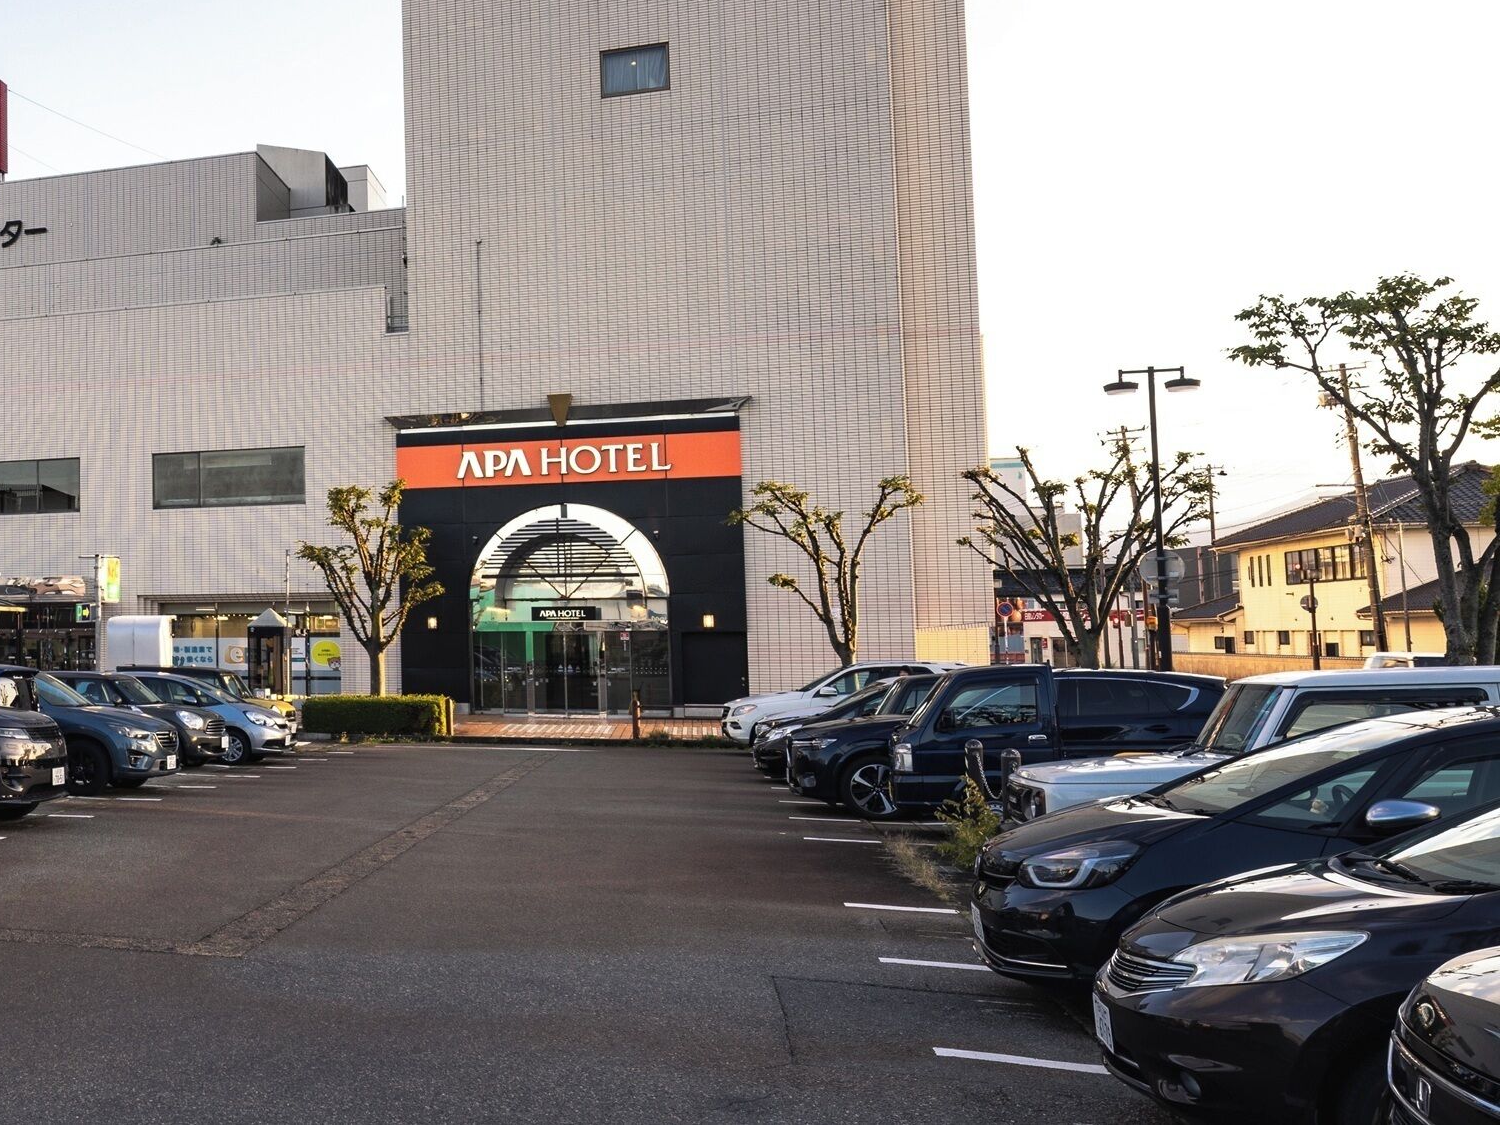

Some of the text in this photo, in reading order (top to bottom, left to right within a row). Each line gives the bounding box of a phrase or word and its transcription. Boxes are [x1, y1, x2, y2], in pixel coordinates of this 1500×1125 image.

[456, 442, 673, 479] APA HOTEL
[539, 608, 587, 618] APA HOTEL
